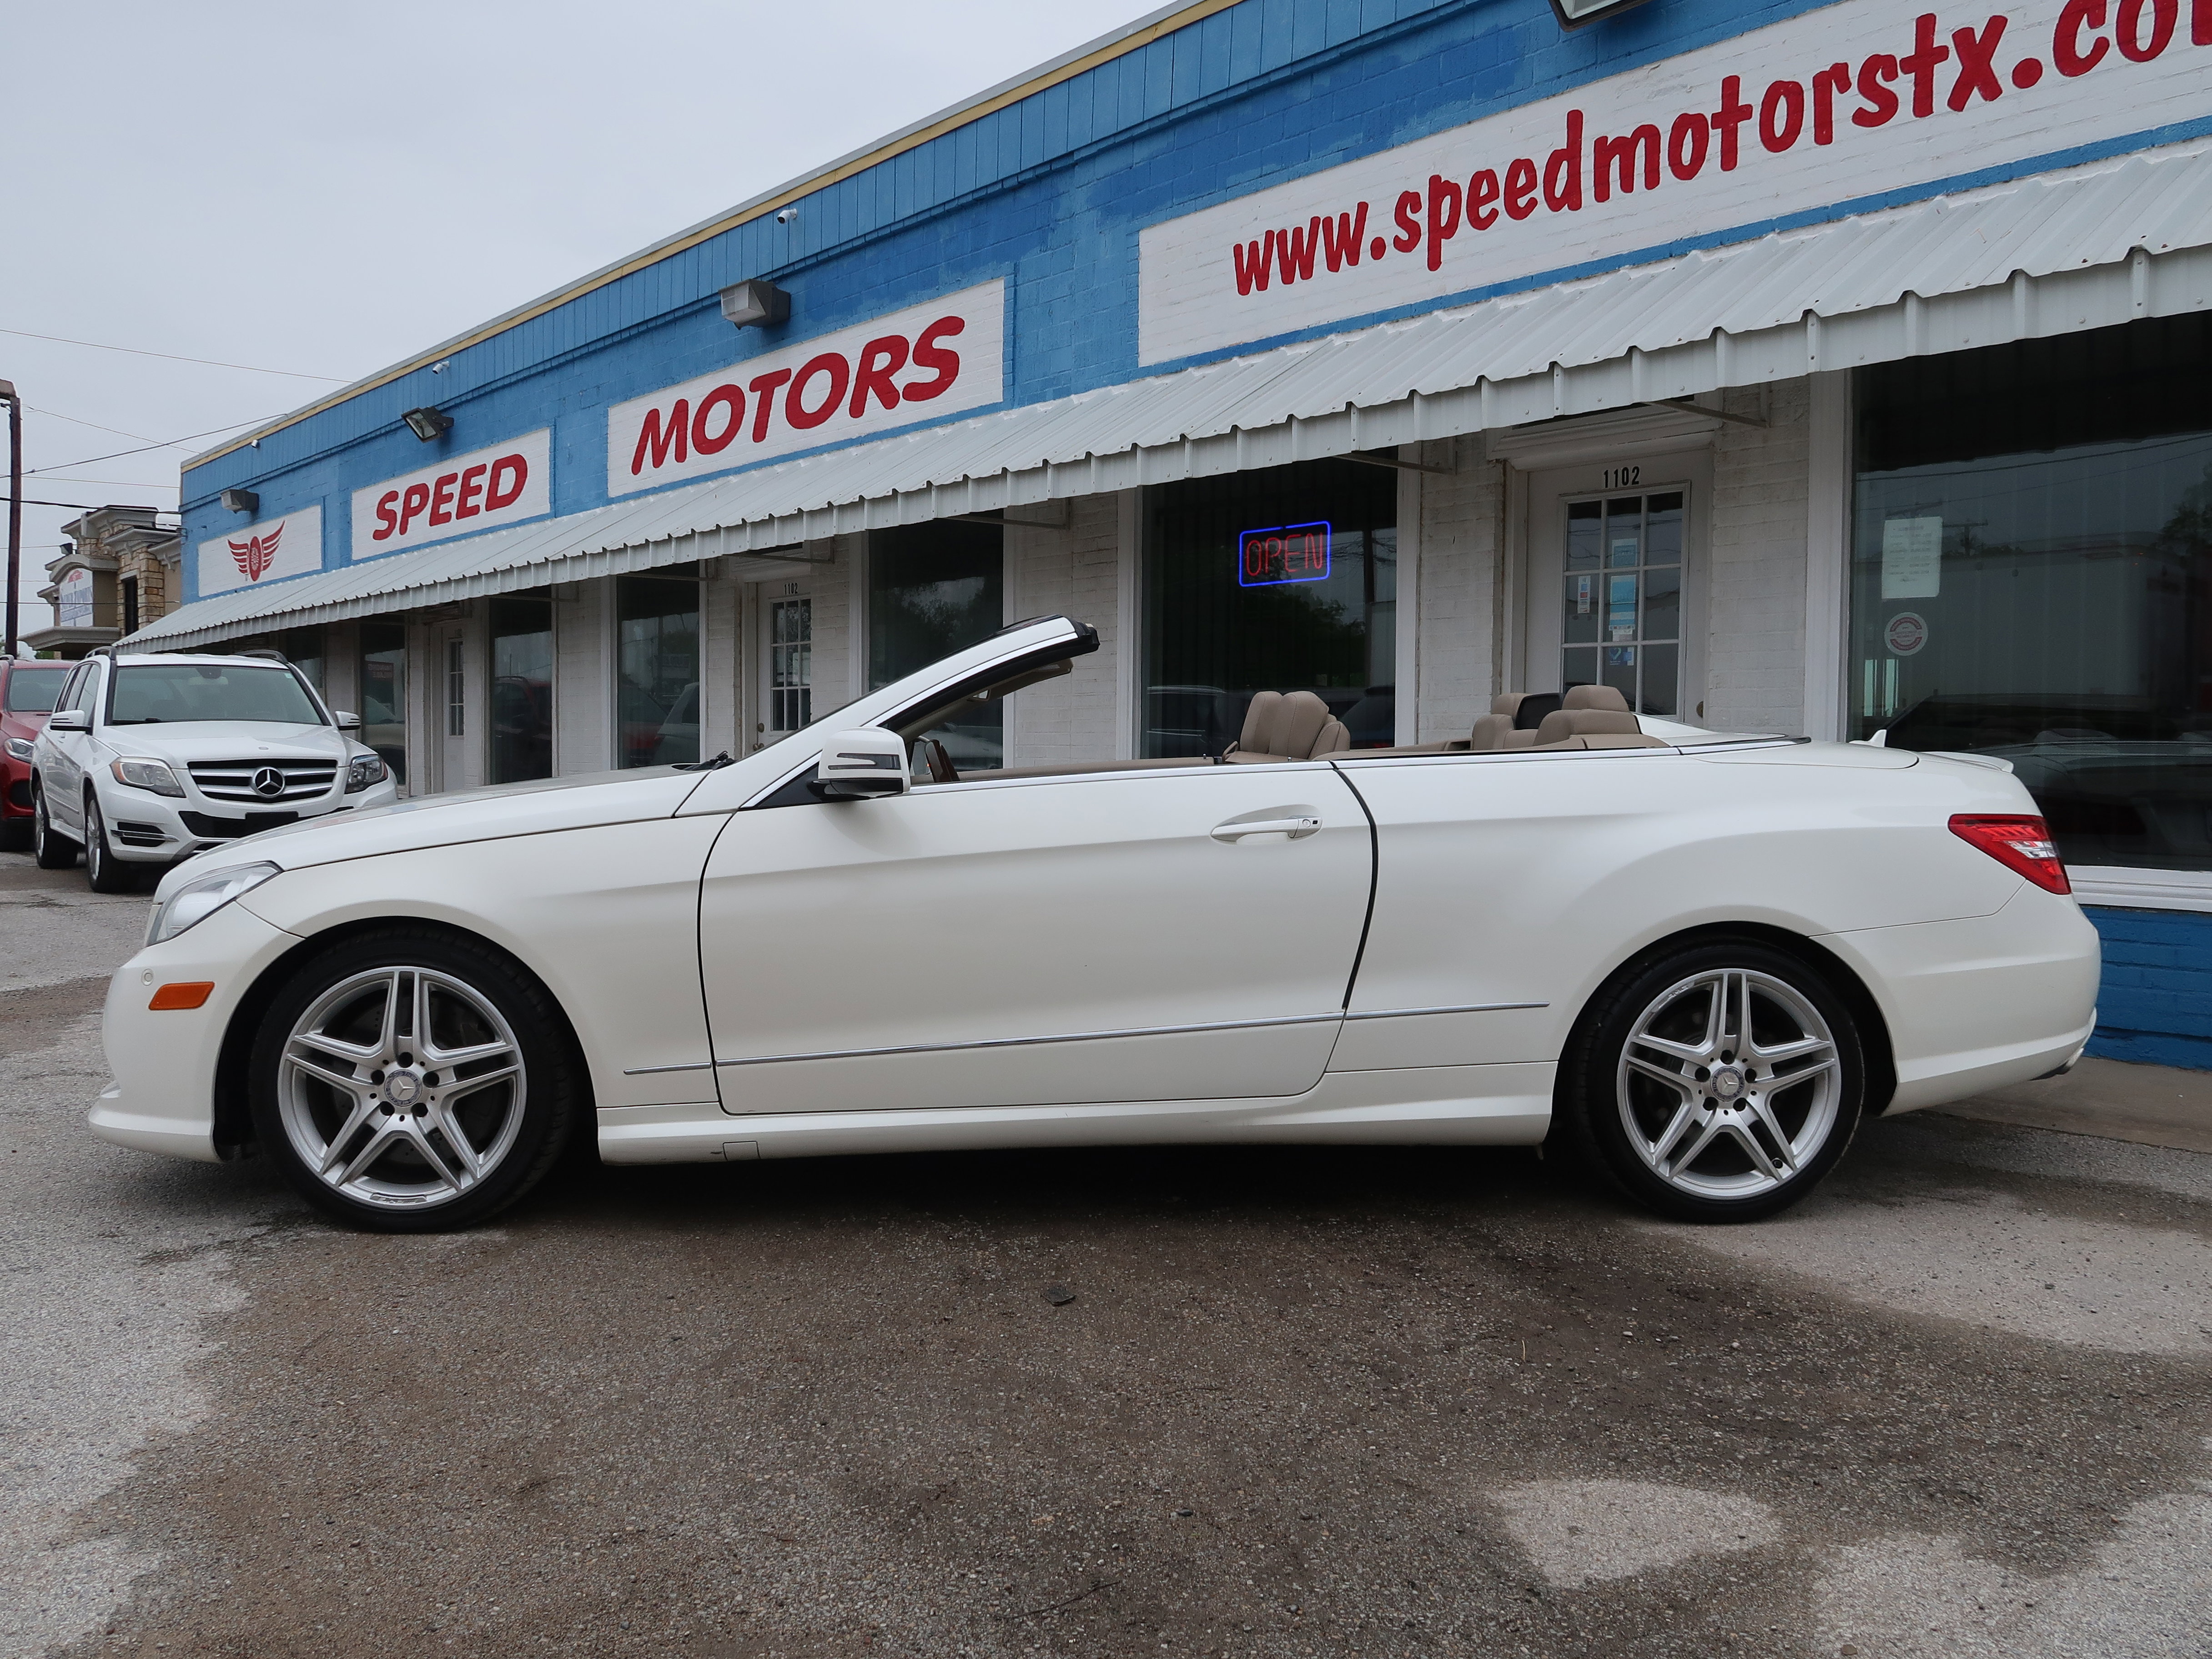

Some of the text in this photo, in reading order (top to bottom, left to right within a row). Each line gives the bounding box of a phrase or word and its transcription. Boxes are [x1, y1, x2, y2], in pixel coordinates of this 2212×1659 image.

[1233, 0, 2212, 296] www.speedmotorstx.co
[631, 316, 965, 475] MOTORS
[373, 454, 528, 541] SPEED
[1604, 466, 1640, 488] 1102
[1246, 532, 1323, 577] OPEN
[784, 582, 798, 595] 1102
